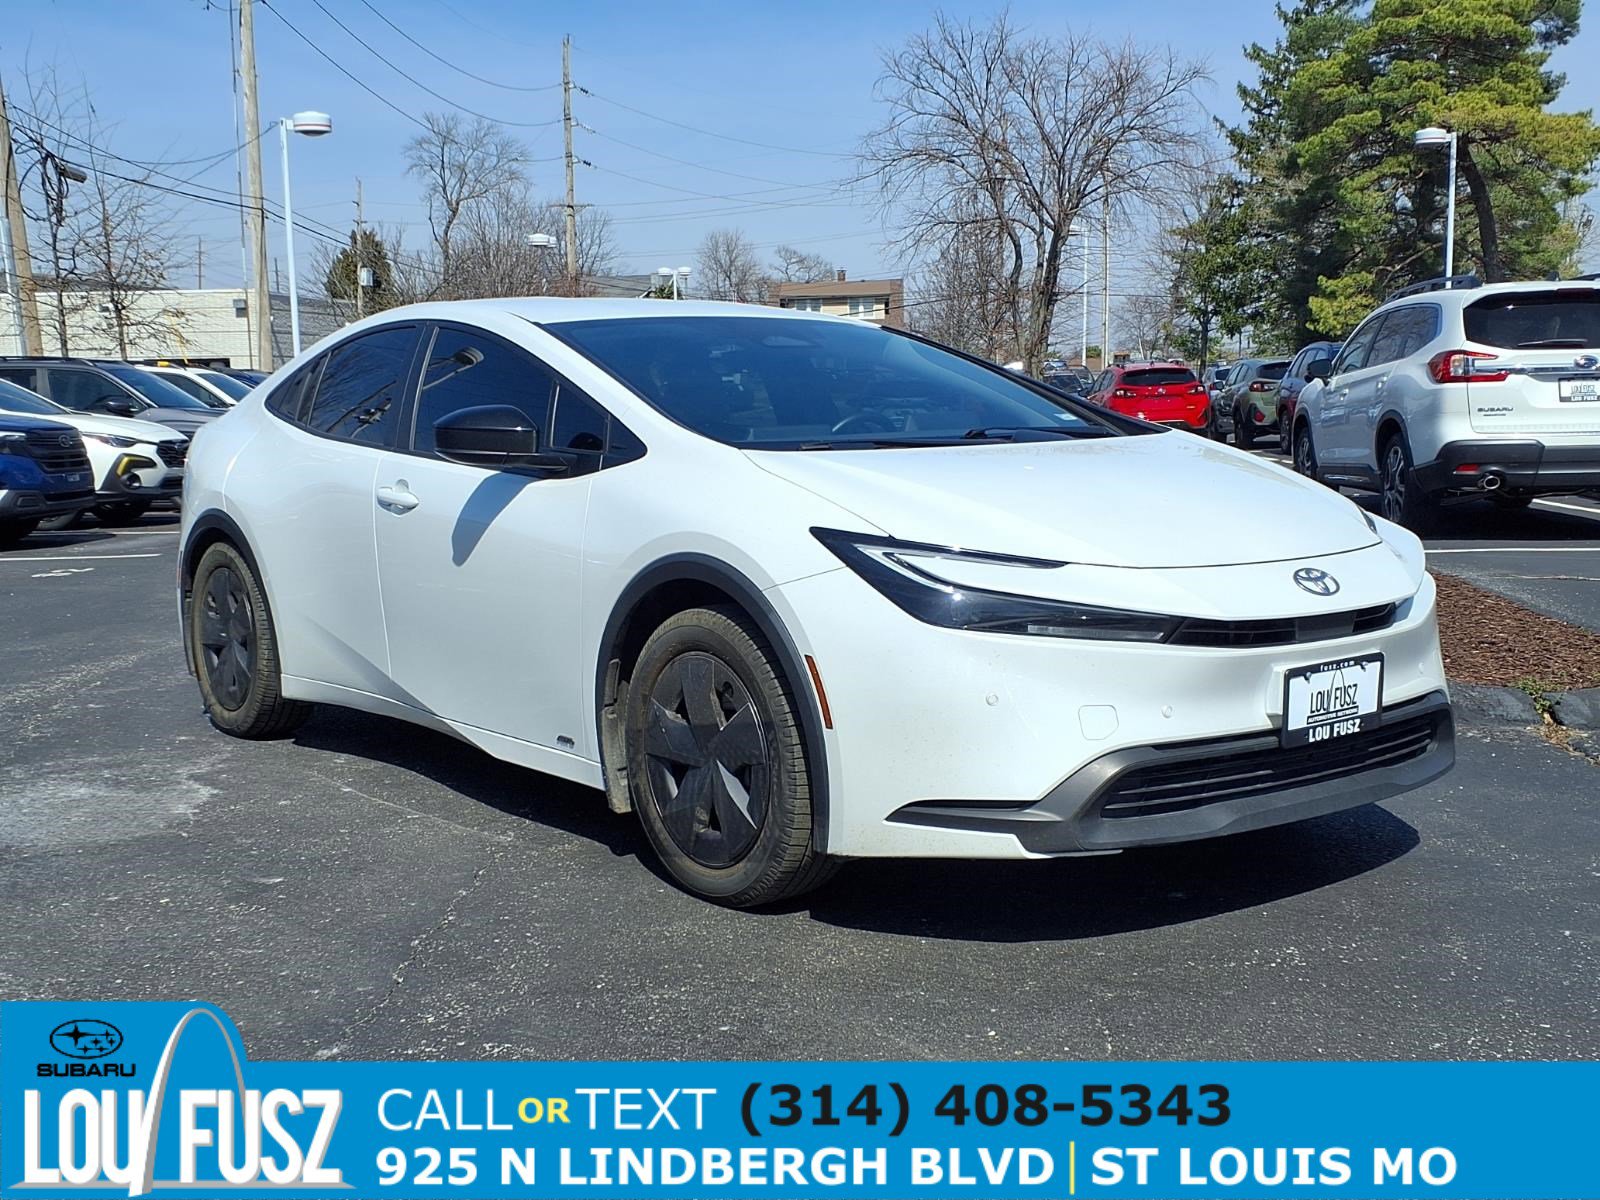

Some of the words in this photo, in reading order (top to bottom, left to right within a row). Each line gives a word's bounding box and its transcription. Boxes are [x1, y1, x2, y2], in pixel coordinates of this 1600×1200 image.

[1310, 689, 1330, 714] LOU
[1334, 684, 1358, 709] FUSZ
[1309, 725, 1330, 743] LOU
[1333, 719, 1361, 737] FUSZ
